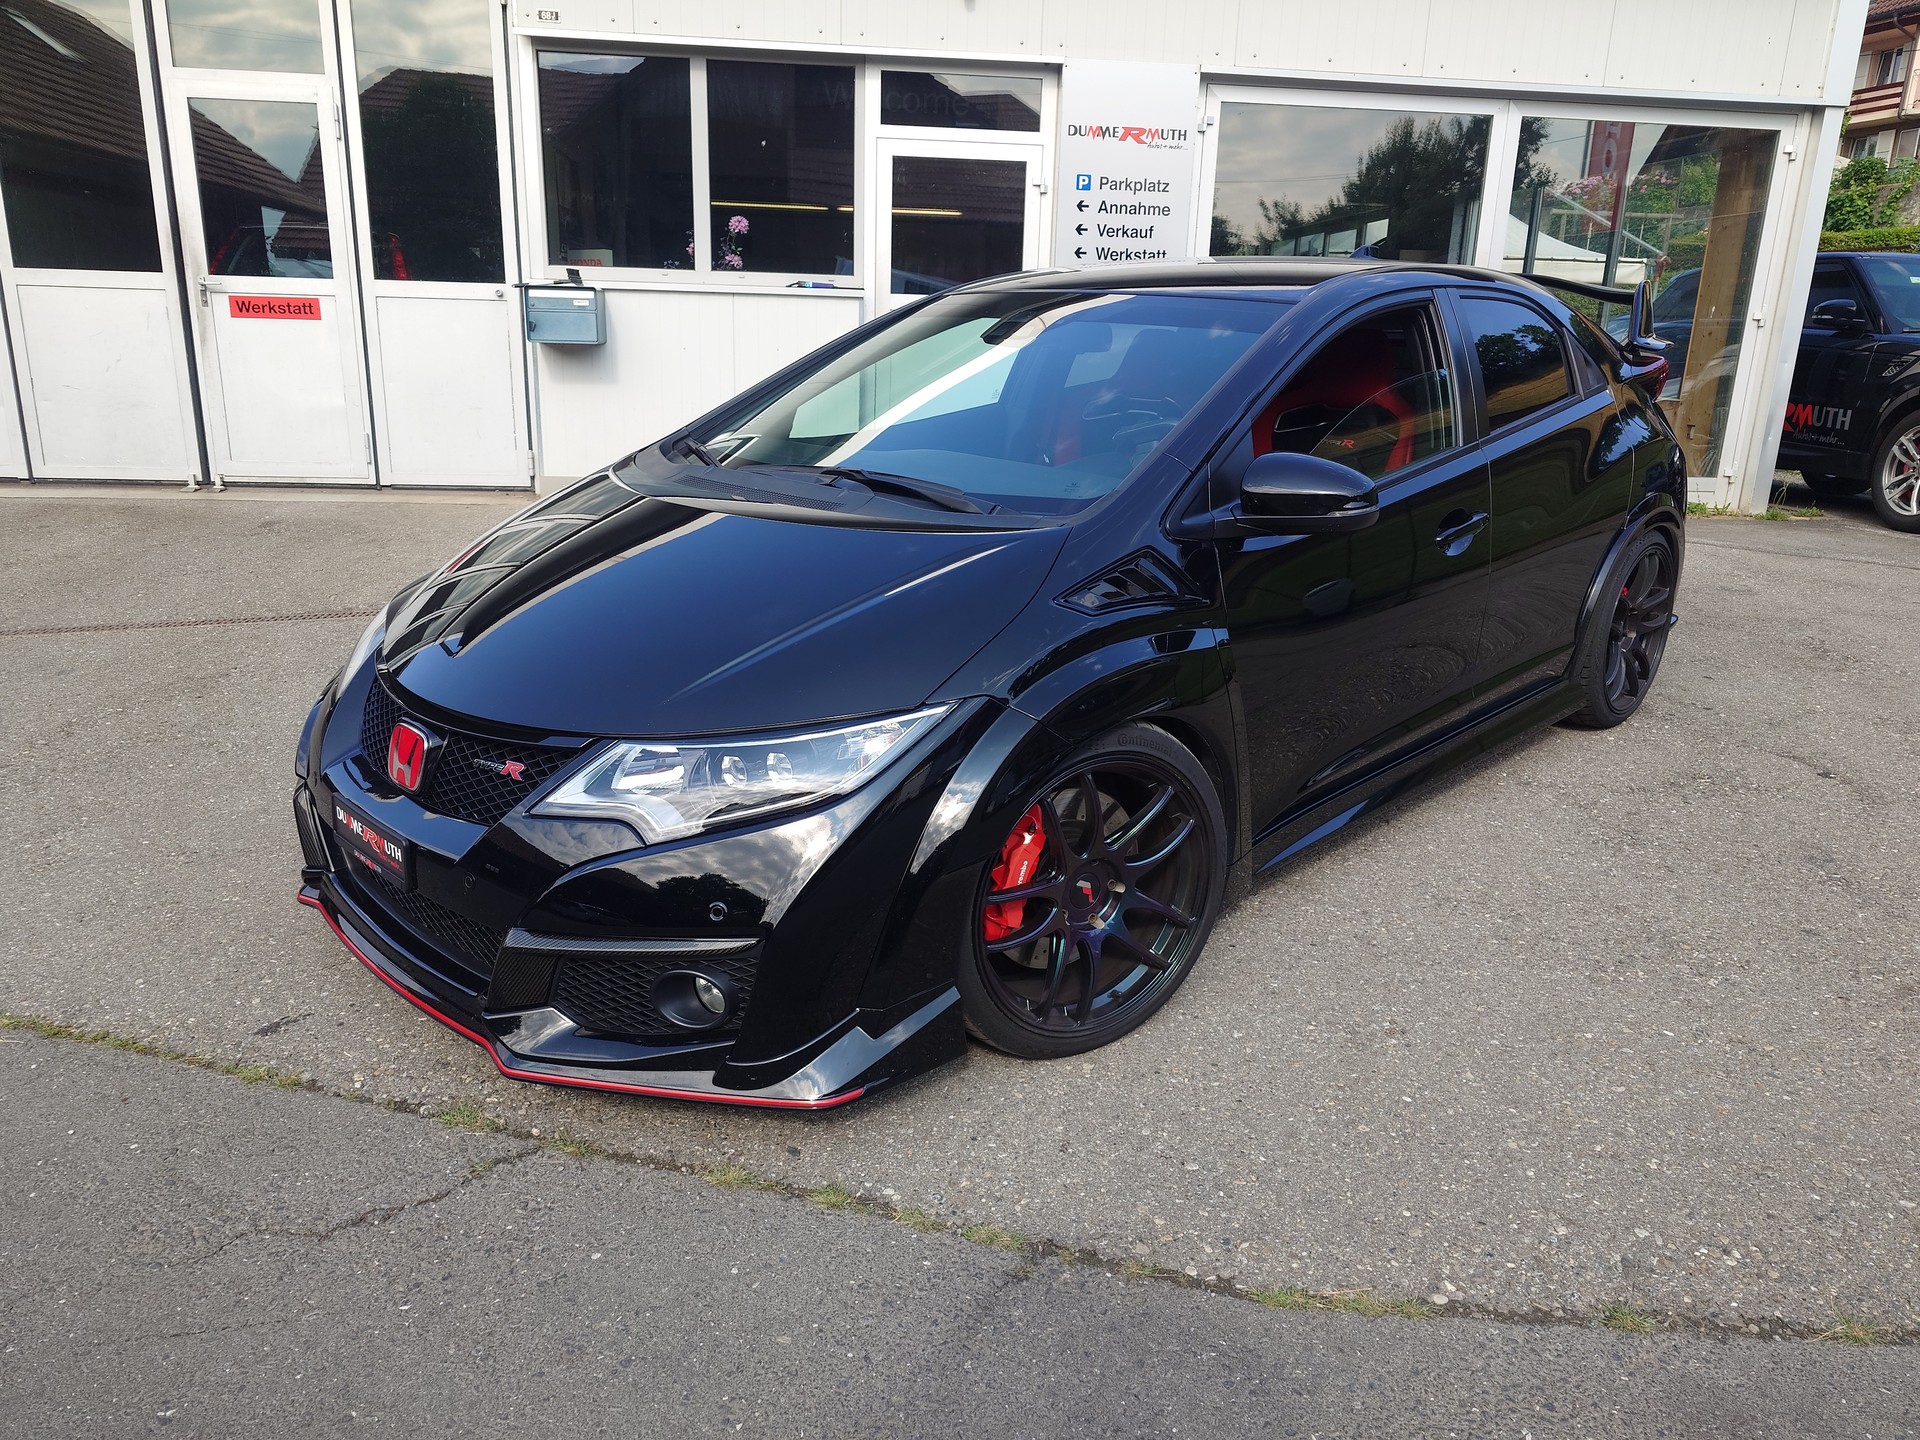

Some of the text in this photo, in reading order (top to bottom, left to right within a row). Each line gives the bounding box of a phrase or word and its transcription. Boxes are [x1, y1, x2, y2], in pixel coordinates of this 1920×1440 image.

[1068, 124, 1188, 145] DUMMERMUTH
[1099, 176, 1170, 195] Parkplatz
[1097, 200, 1171, 217] Annahme
[1096, 223, 1154, 239] Verkauf
[1095, 246, 1167, 261] Werkstatt
[235, 299, 314, 315] Werkstatt
[1117, 732, 1173, 757] Continental
[1017, 860, 1029, 886] rembo
